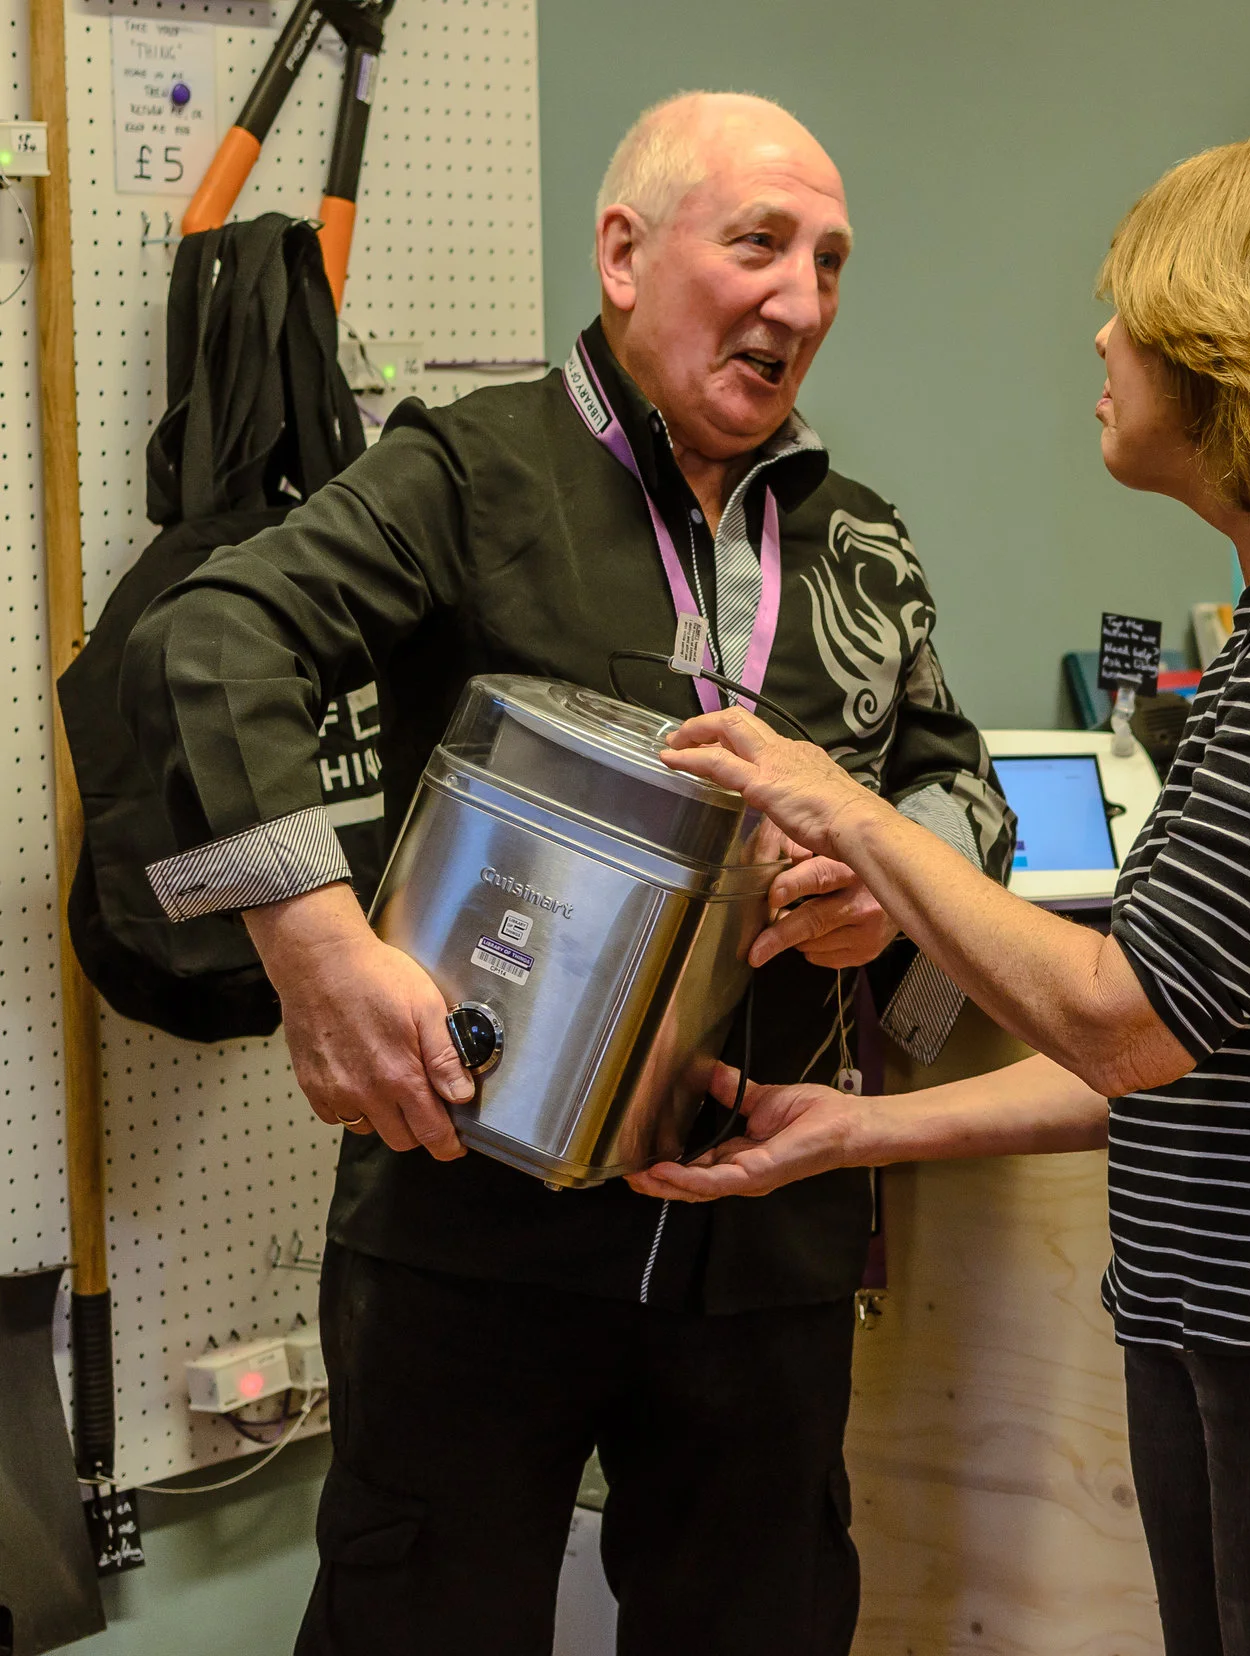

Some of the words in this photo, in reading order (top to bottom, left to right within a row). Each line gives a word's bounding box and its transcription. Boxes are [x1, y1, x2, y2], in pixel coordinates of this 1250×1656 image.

[570, 371, 582, 383] OF
[575, 383, 603, 427] LIBRARY
[480, 866, 574, 920] Cuisinart
[508, 917, 526, 928] LIBRARY
[505, 928, 521, 938] THINGS
[483, 939, 504, 953] LIBRARY
[512, 953, 531, 964] THINGS
